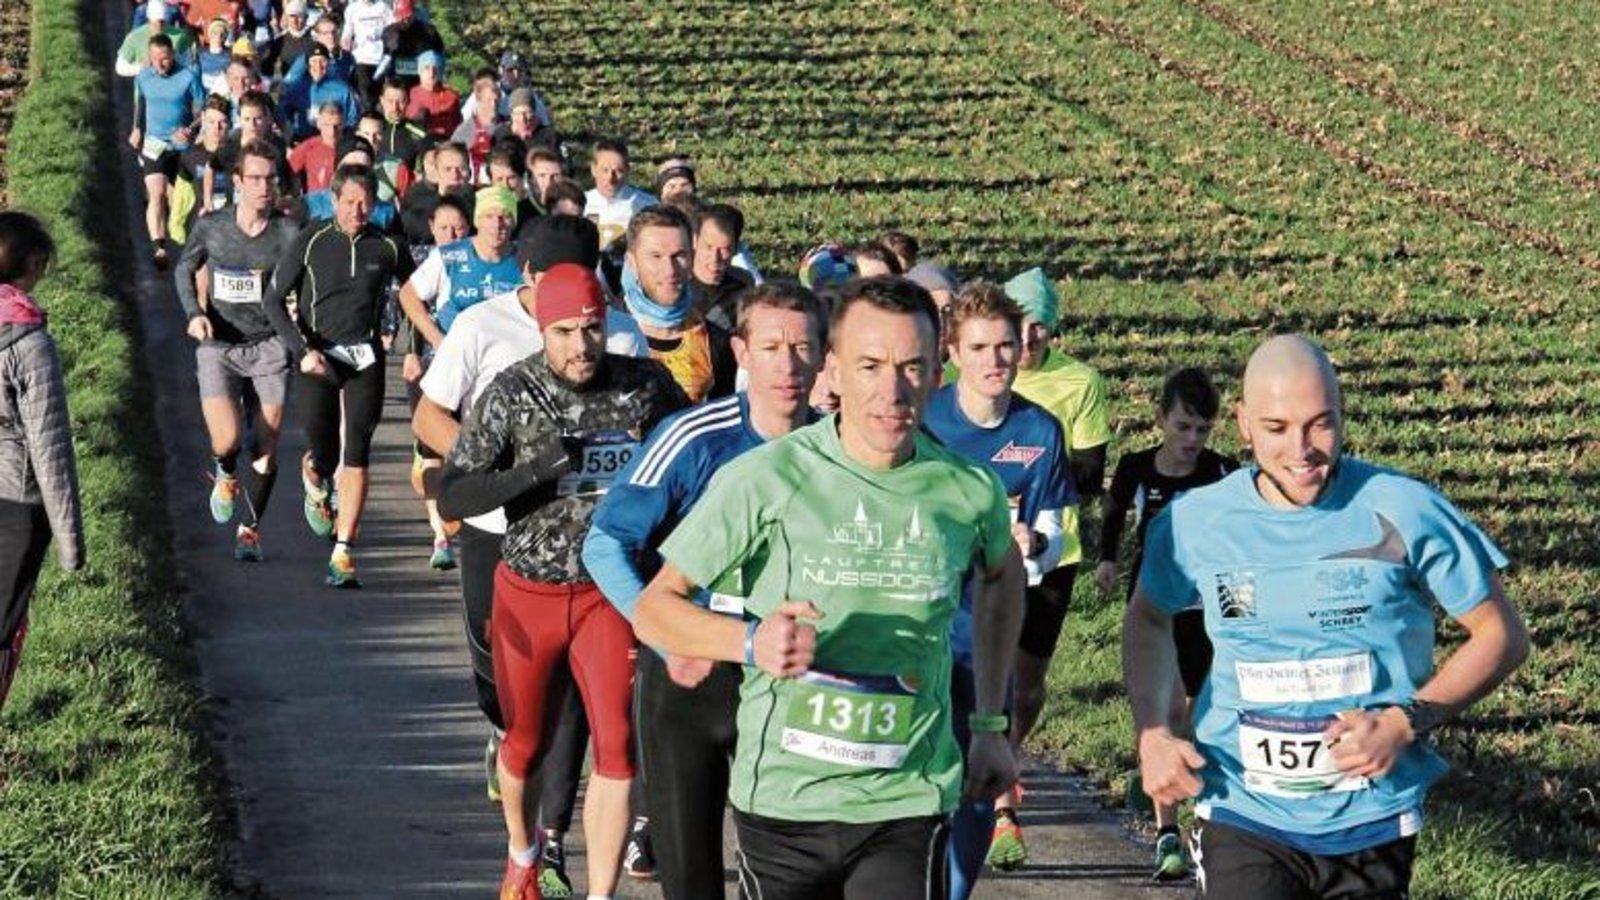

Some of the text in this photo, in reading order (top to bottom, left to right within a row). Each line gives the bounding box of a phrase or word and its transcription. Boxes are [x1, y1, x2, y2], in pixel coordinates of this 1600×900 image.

[585, 448, 632, 474] 539
[807, 691, 897, 736] 1313
[818, 741, 876, 761] Andreas
[1257, 738, 1322, 770] 157
